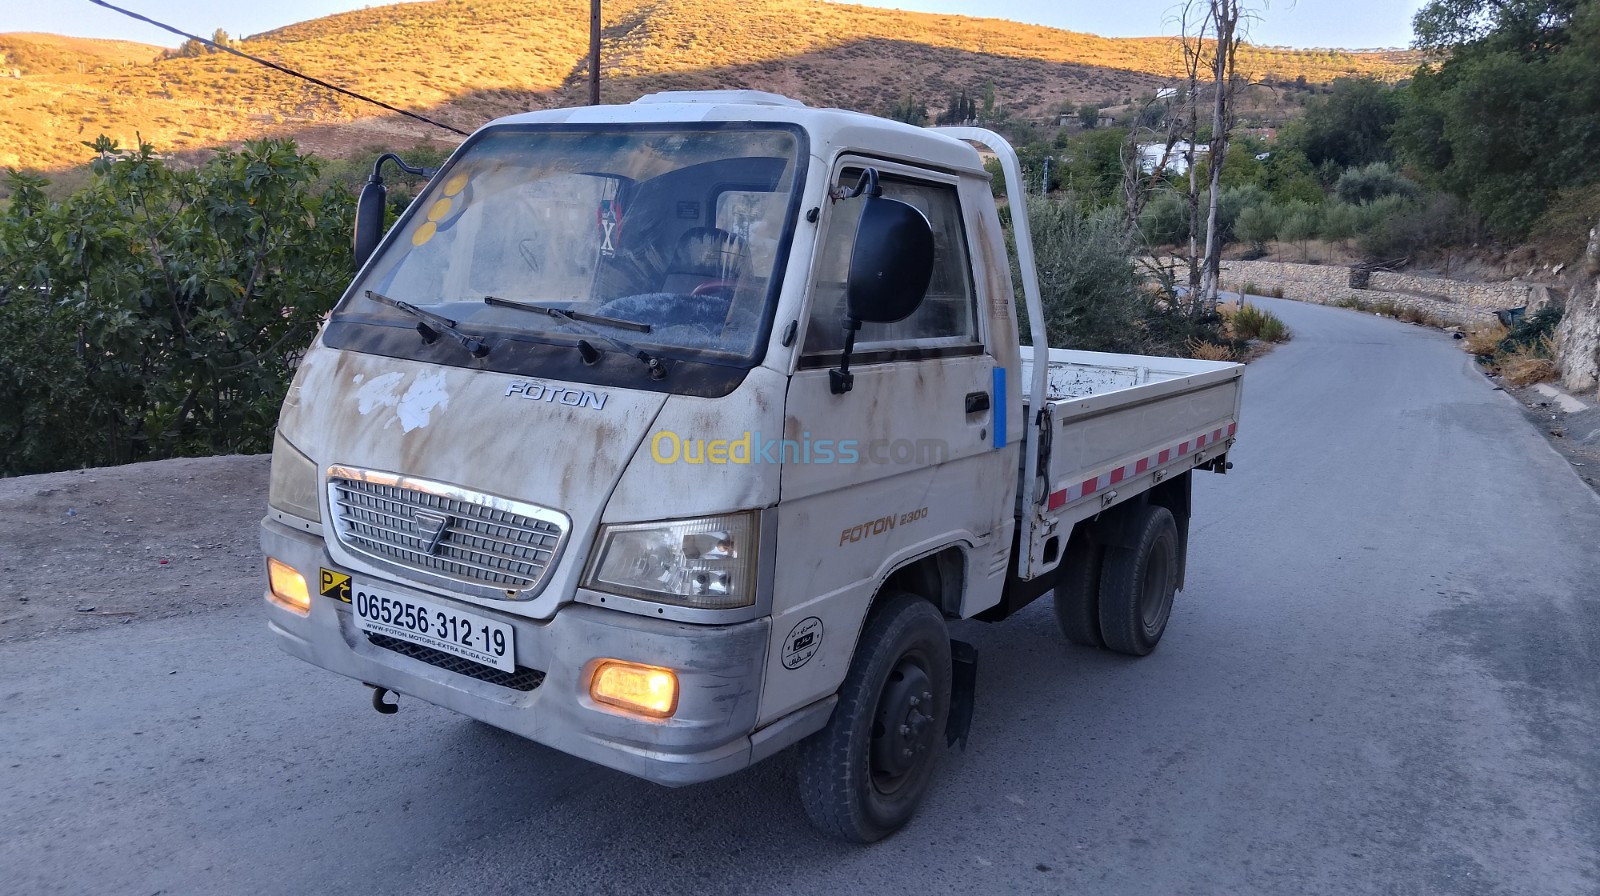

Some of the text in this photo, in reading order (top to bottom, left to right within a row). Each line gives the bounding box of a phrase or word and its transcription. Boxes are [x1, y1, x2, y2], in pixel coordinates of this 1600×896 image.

[505, 381, 608, 410] FOTON
[839, 506, 929, 547] FOTON 2300
[322, 569, 333, 590] P
